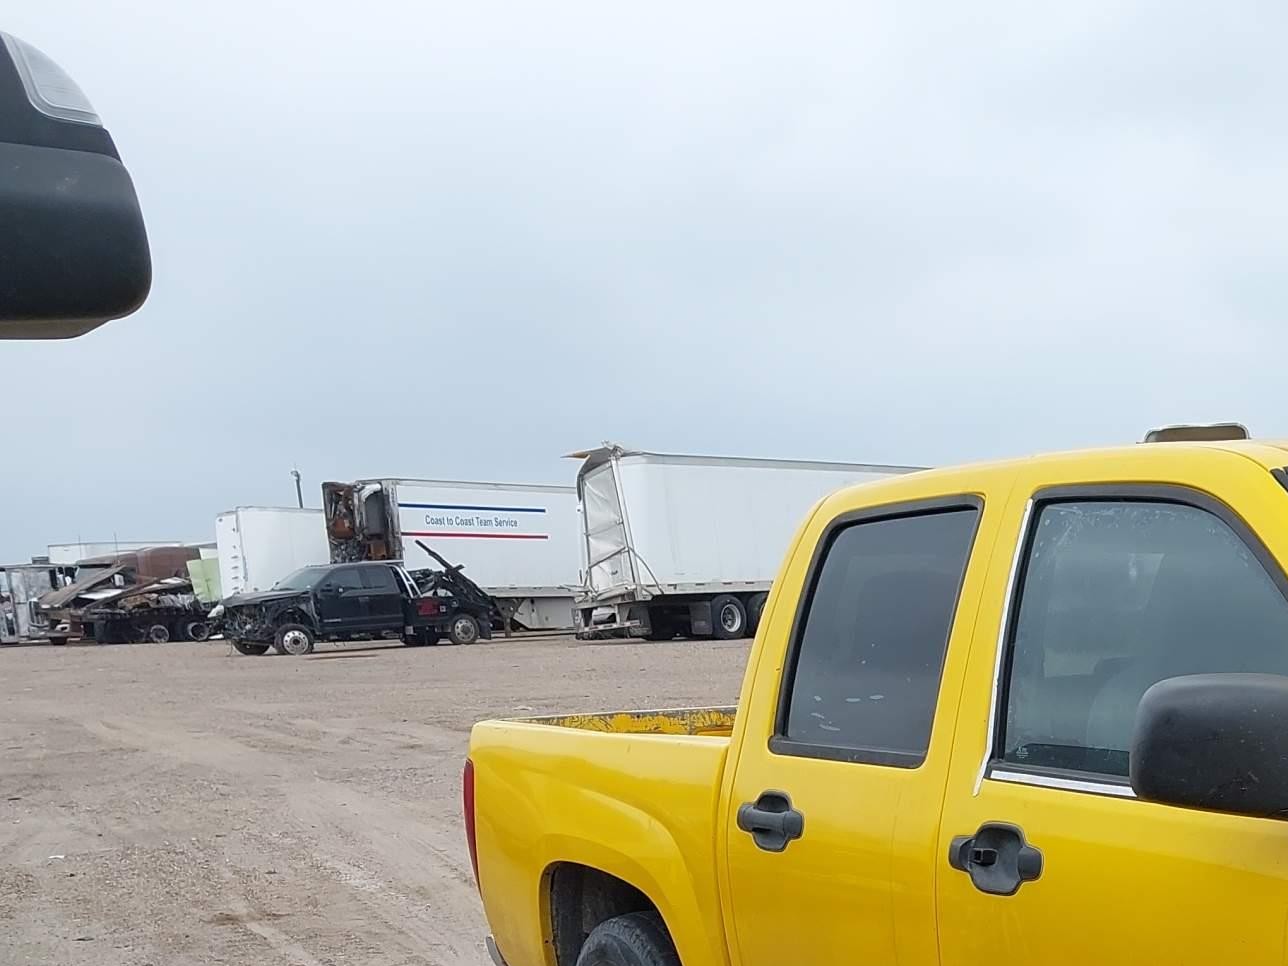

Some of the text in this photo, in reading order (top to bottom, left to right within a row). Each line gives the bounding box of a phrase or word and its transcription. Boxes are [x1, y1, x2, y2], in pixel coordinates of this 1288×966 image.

[425, 515, 518, 528] Coast to Coast Team Service
